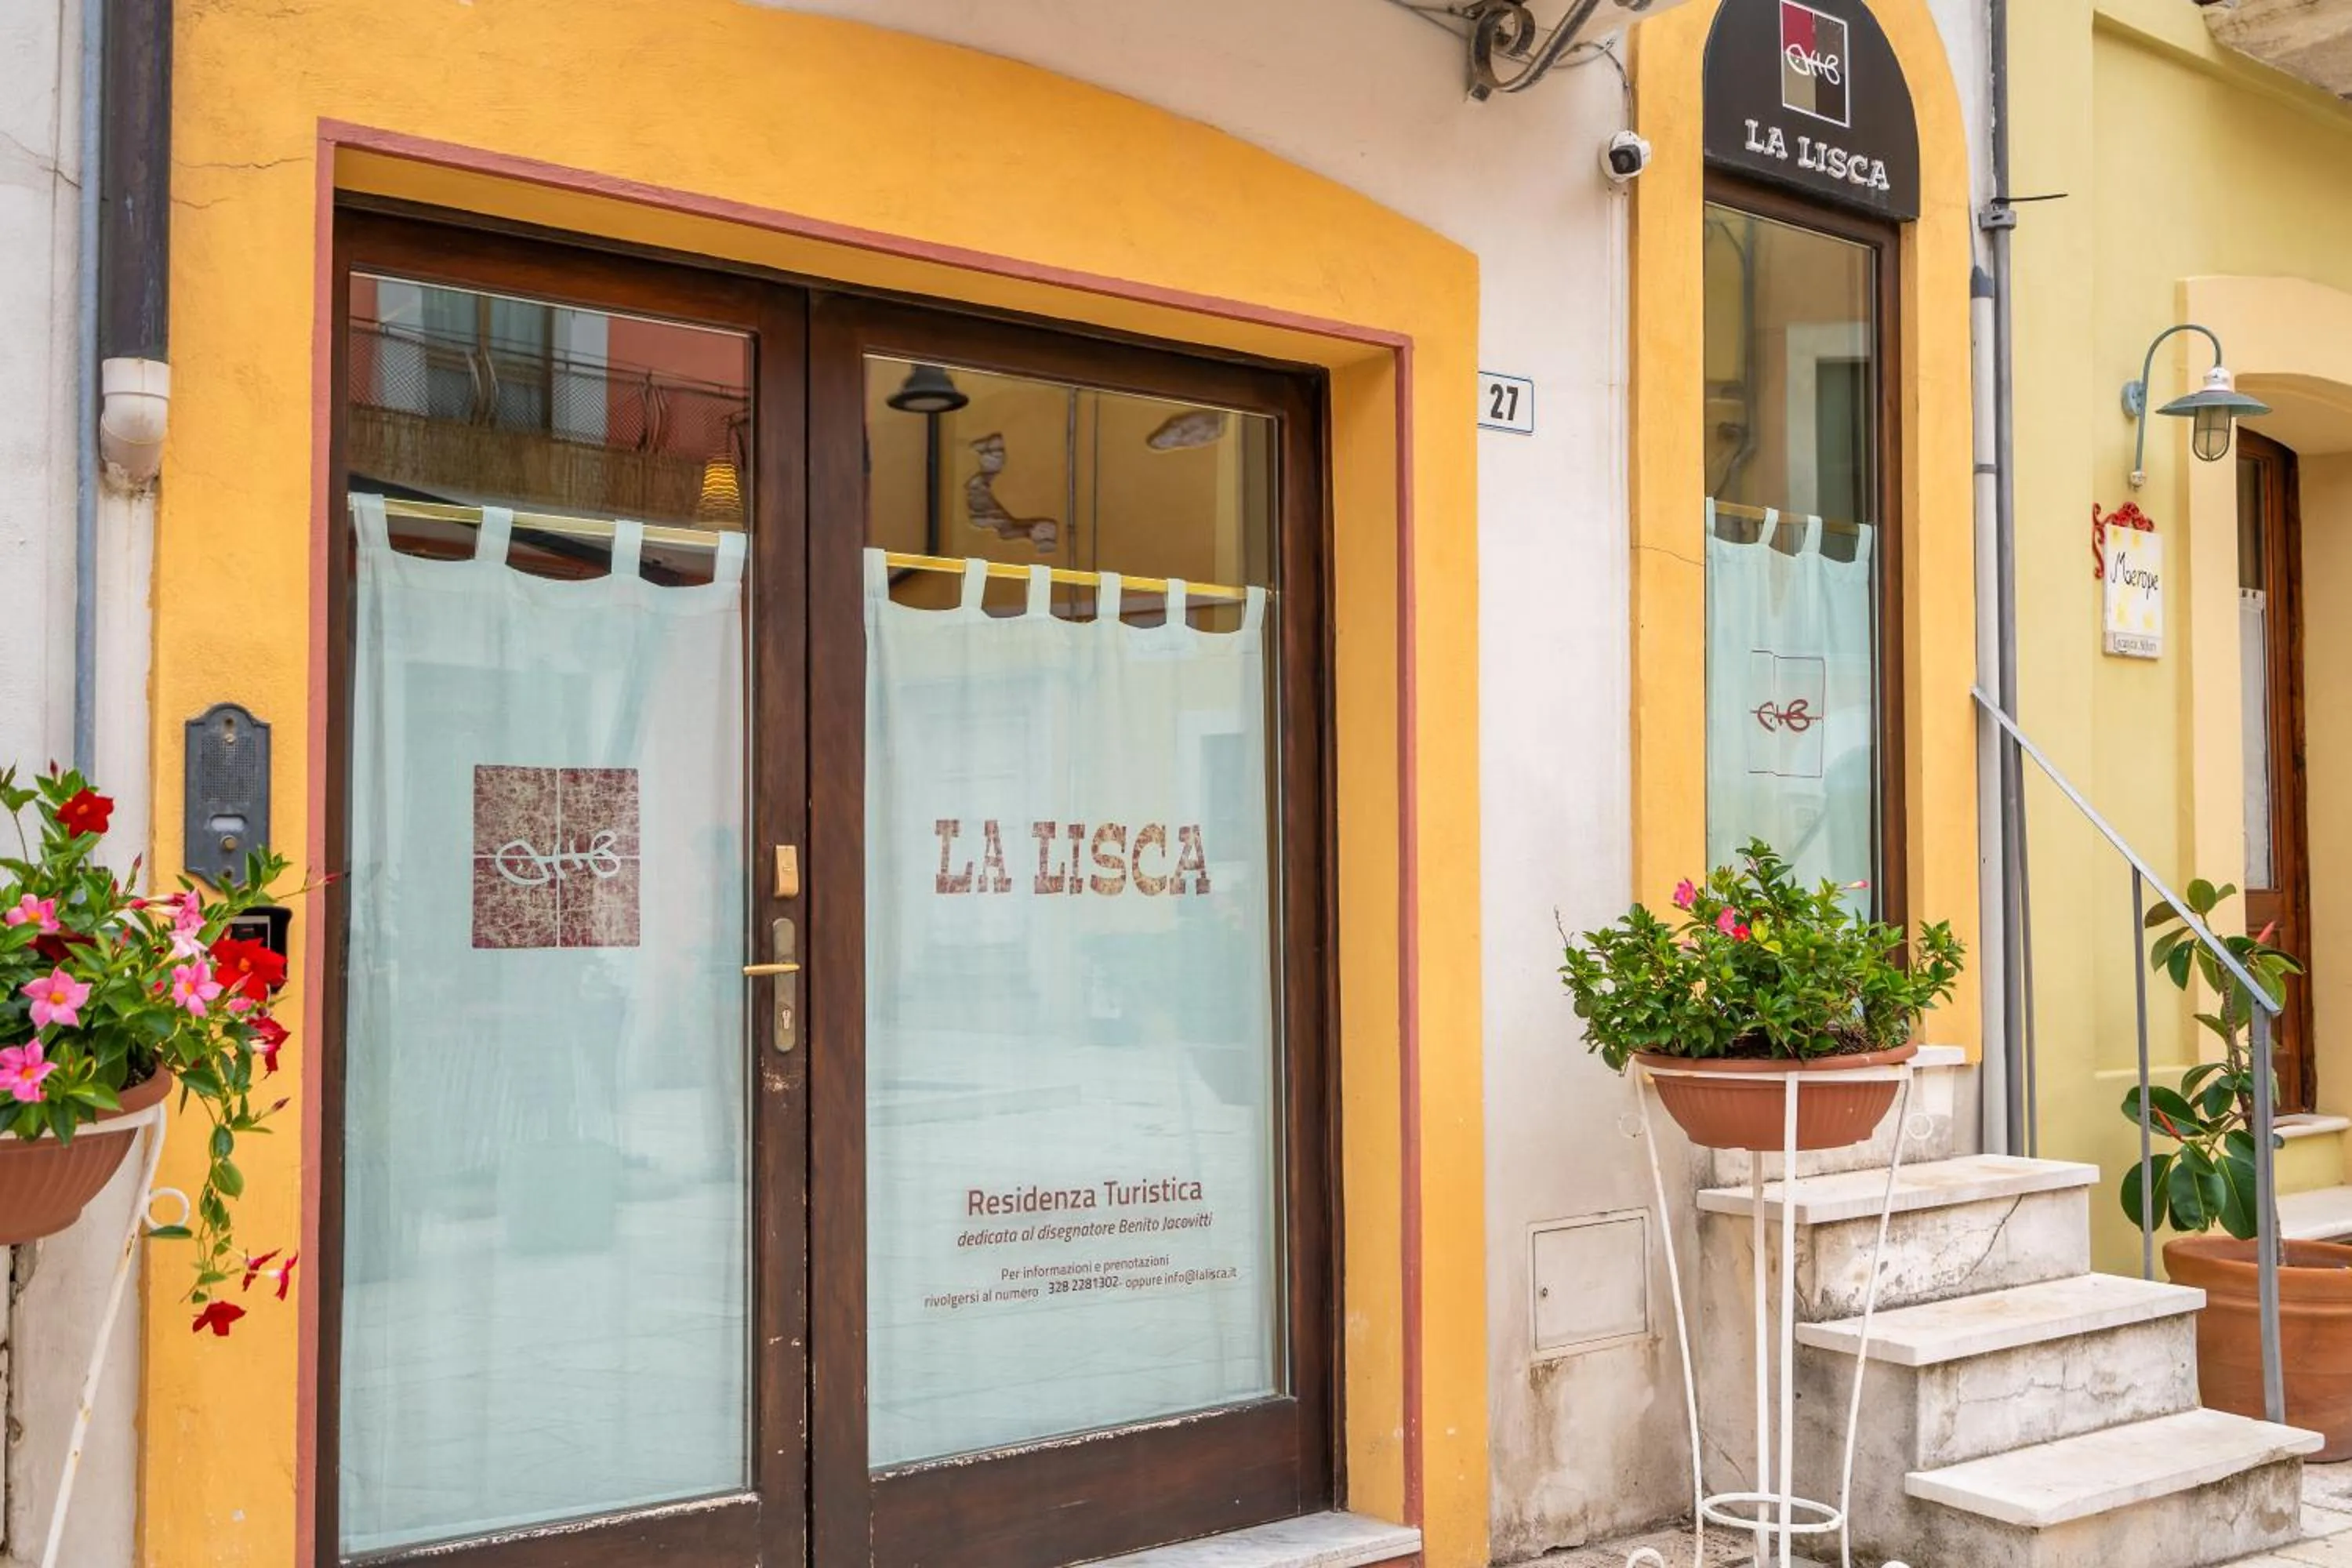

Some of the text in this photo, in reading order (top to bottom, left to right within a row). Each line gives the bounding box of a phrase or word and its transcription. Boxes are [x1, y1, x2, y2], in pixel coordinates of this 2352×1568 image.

[1744, 118, 1890, 190] LA LISCA
[1490, 383, 1519, 421] 27
[2110, 551, 2158, 601] Merope
[934, 818, 1212, 897] LA LISCA
[967, 1176, 1203, 1216] Residenza Turistica
[956, 1211, 1214, 1247] dedicata al disegnatore Benito Jacovitti
[924, 1290, 979, 1309] rivolgersi
[982, 1290, 993, 1303] al
[994, 1286, 1040, 1301] numero
[1047, 1279, 1069, 1295] 328
[1124, 1271, 1162, 1290] oppure
[1163, 1266, 1237, 1285] info@lalisca.it
[1000, 1254, 1170, 1280] Per informazioni e prenotazioni
